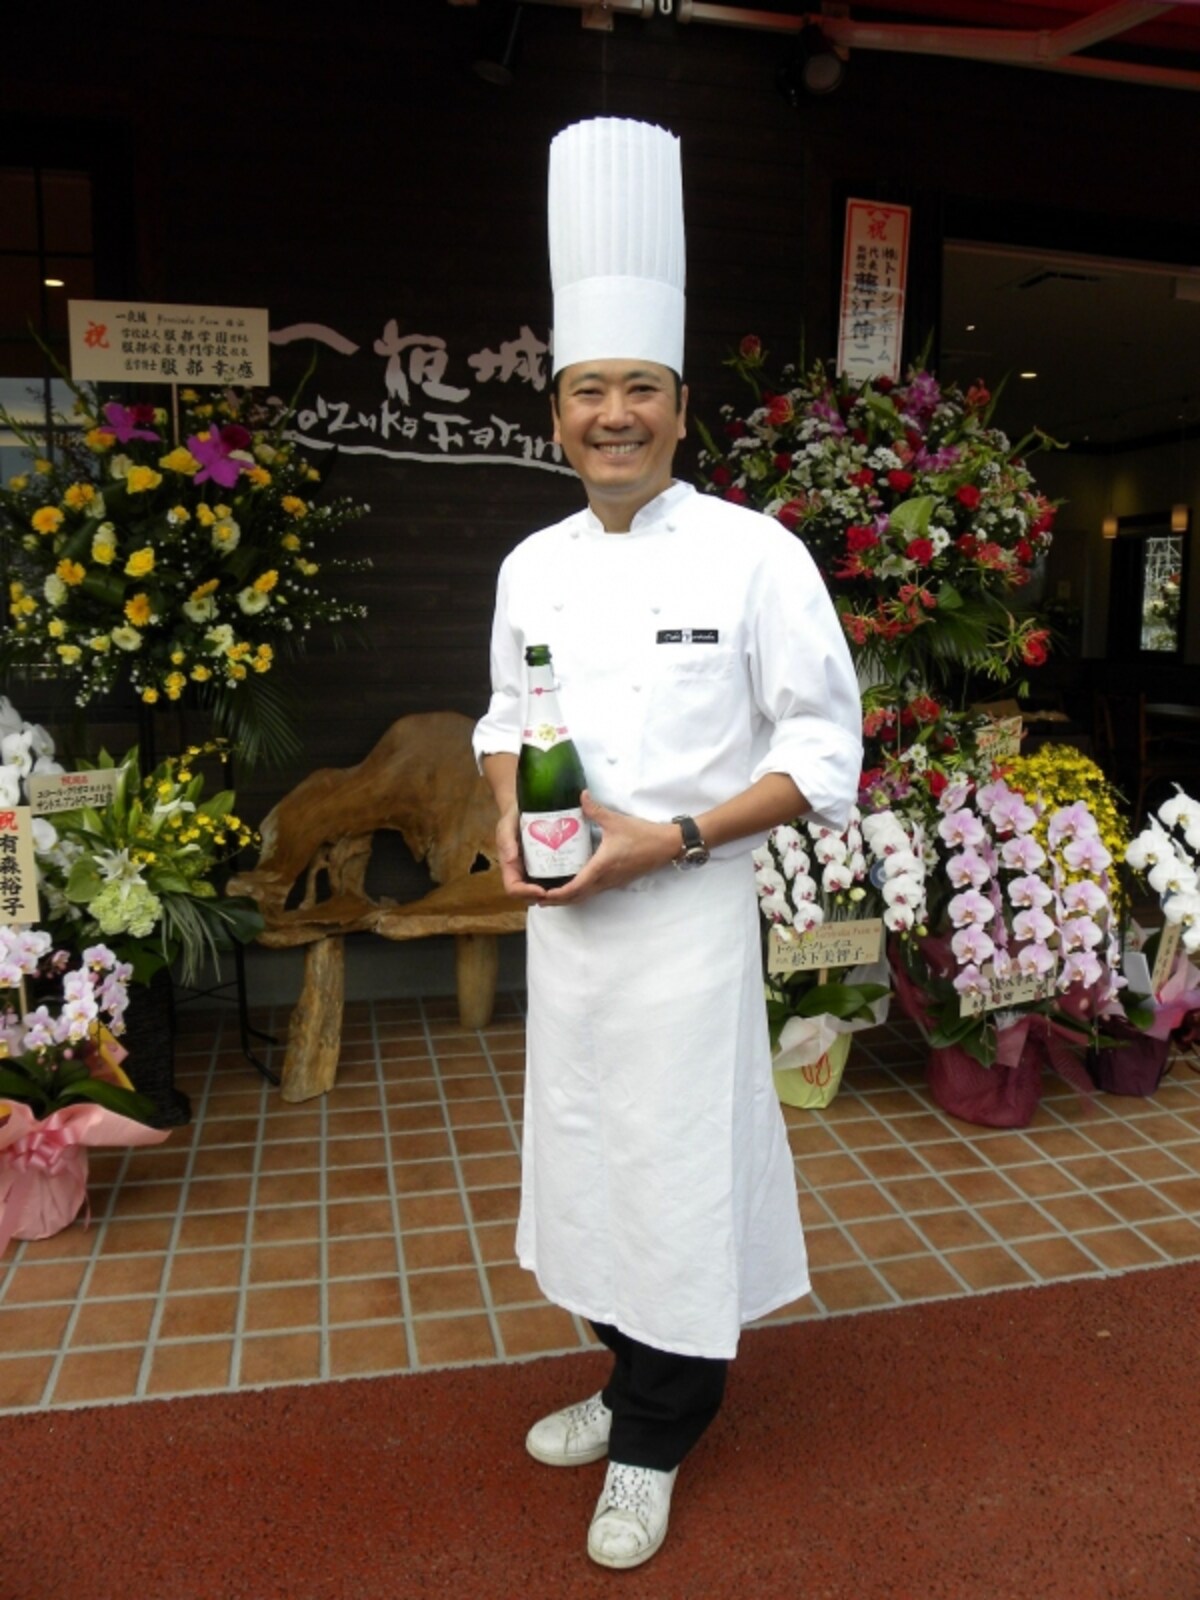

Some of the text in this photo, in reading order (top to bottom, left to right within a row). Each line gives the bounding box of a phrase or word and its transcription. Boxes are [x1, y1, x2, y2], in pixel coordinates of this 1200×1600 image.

[867, 217, 888, 241] 祝
[83, 320, 110, 349] 祝
[0, 811, 18, 831] 祝
[0, 834, 25, 916] 有森裕子
